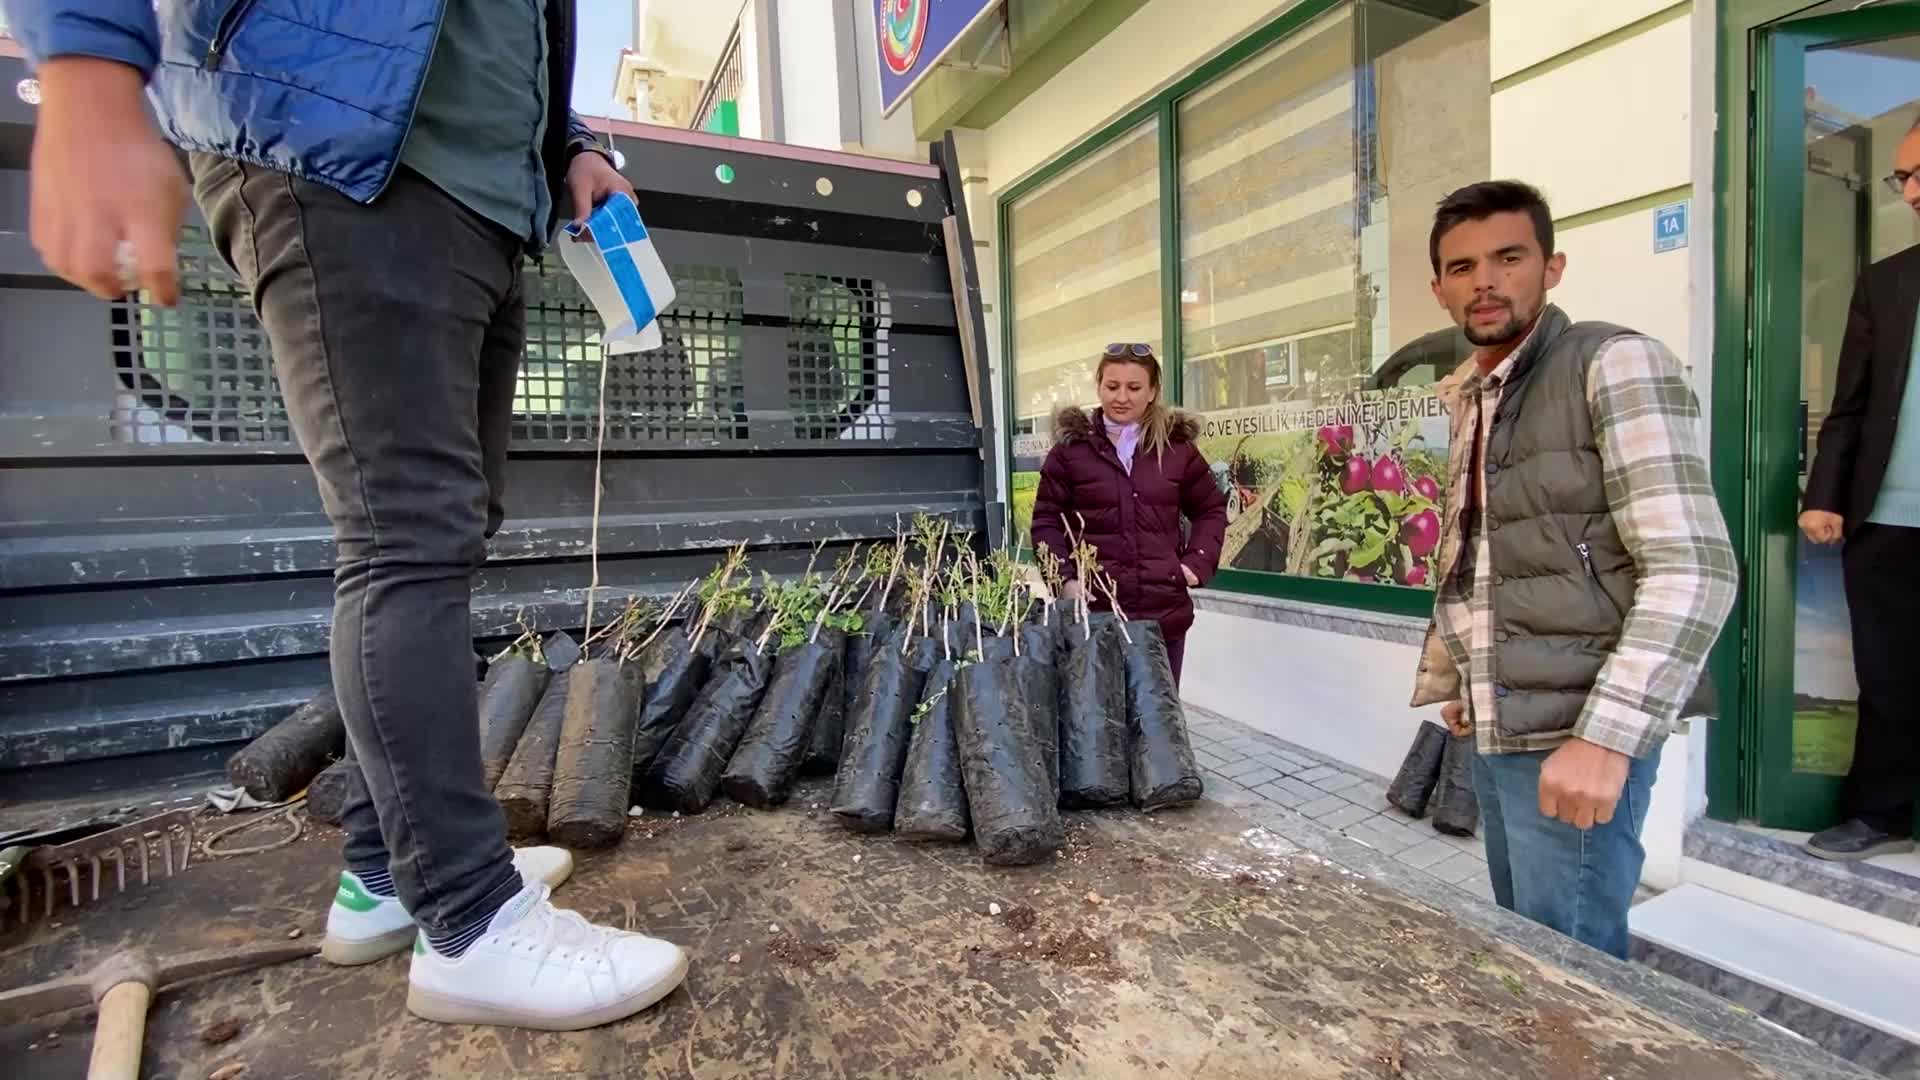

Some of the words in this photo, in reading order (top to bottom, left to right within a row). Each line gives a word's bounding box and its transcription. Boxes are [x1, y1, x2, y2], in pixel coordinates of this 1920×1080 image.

[1661, 216, 1680, 233] 1A
[1216, 418, 1233, 436] VE
[1234, 409, 1290, 438] YEŞİLLİK
[1293, 400, 1381, 430] MEDENİYET
